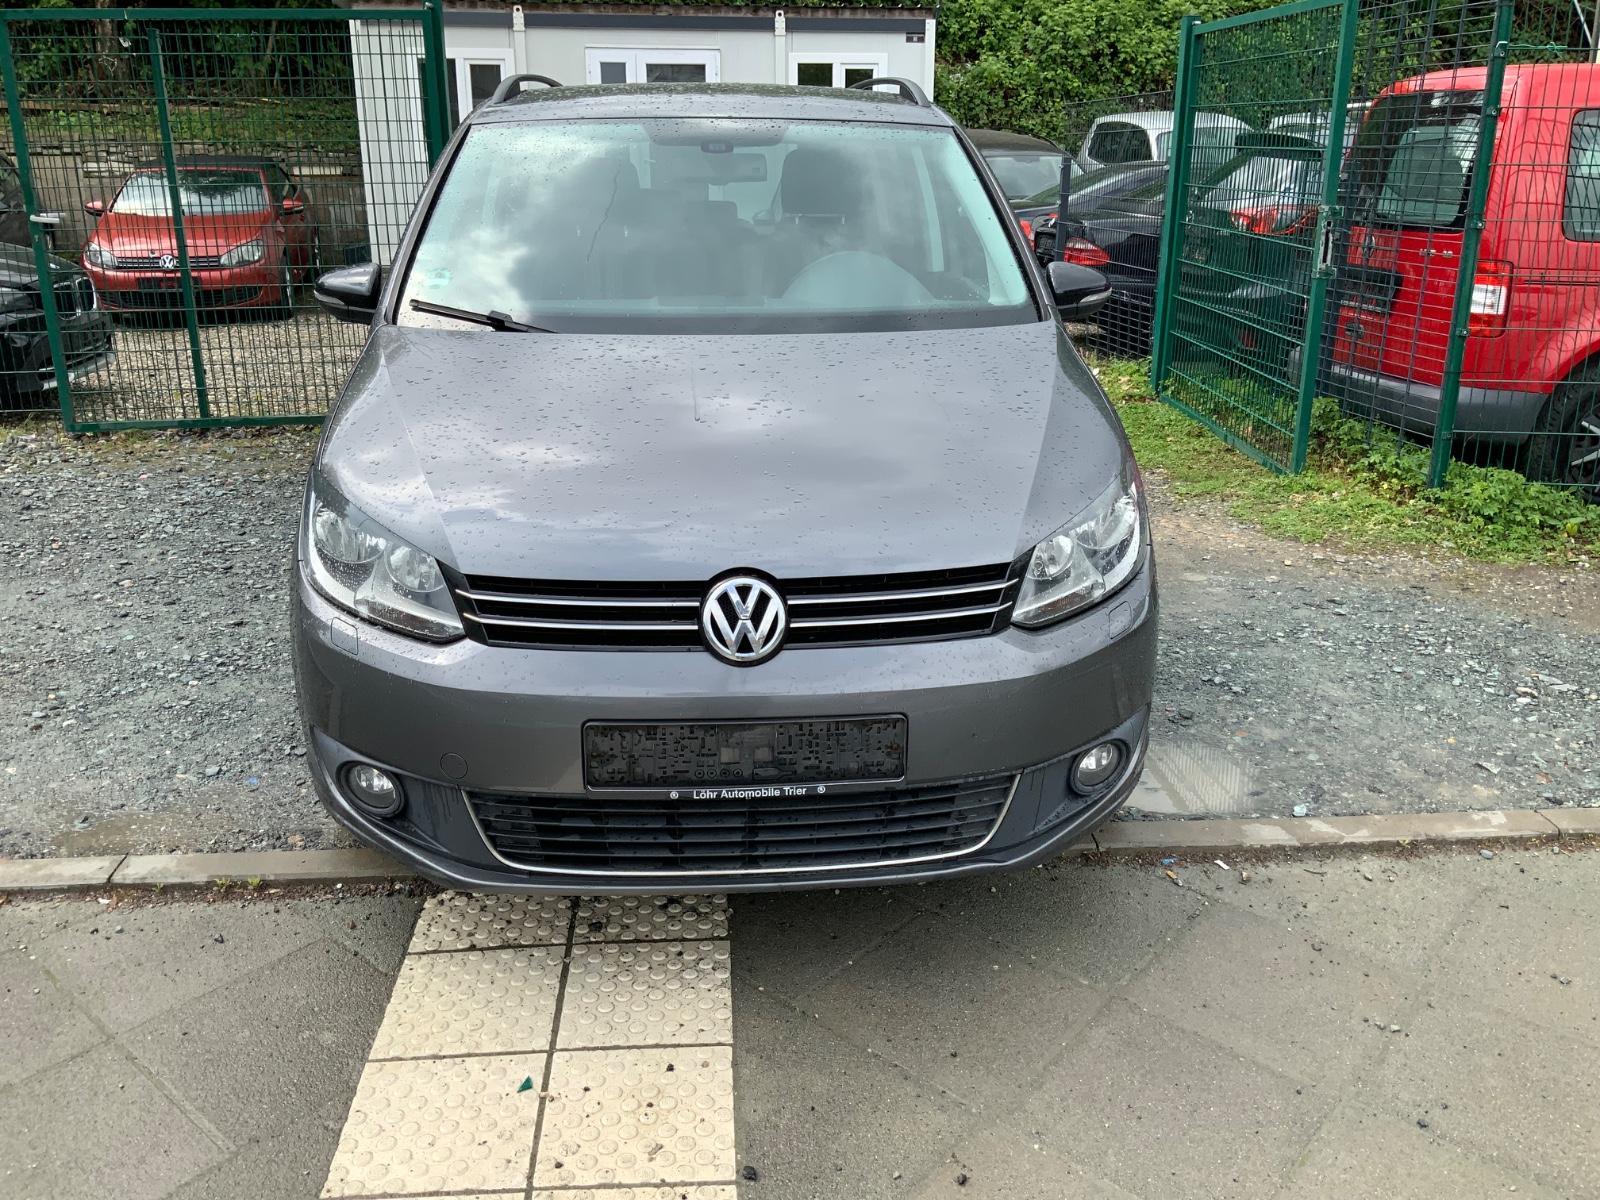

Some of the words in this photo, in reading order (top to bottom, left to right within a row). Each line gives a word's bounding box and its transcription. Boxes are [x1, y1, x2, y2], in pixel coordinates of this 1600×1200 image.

[704, 578, 784, 660] VW
[693, 788, 718, 799] Löhr
[720, 787, 781, 799] Automobile
[783, 786, 807, 796] Trier
